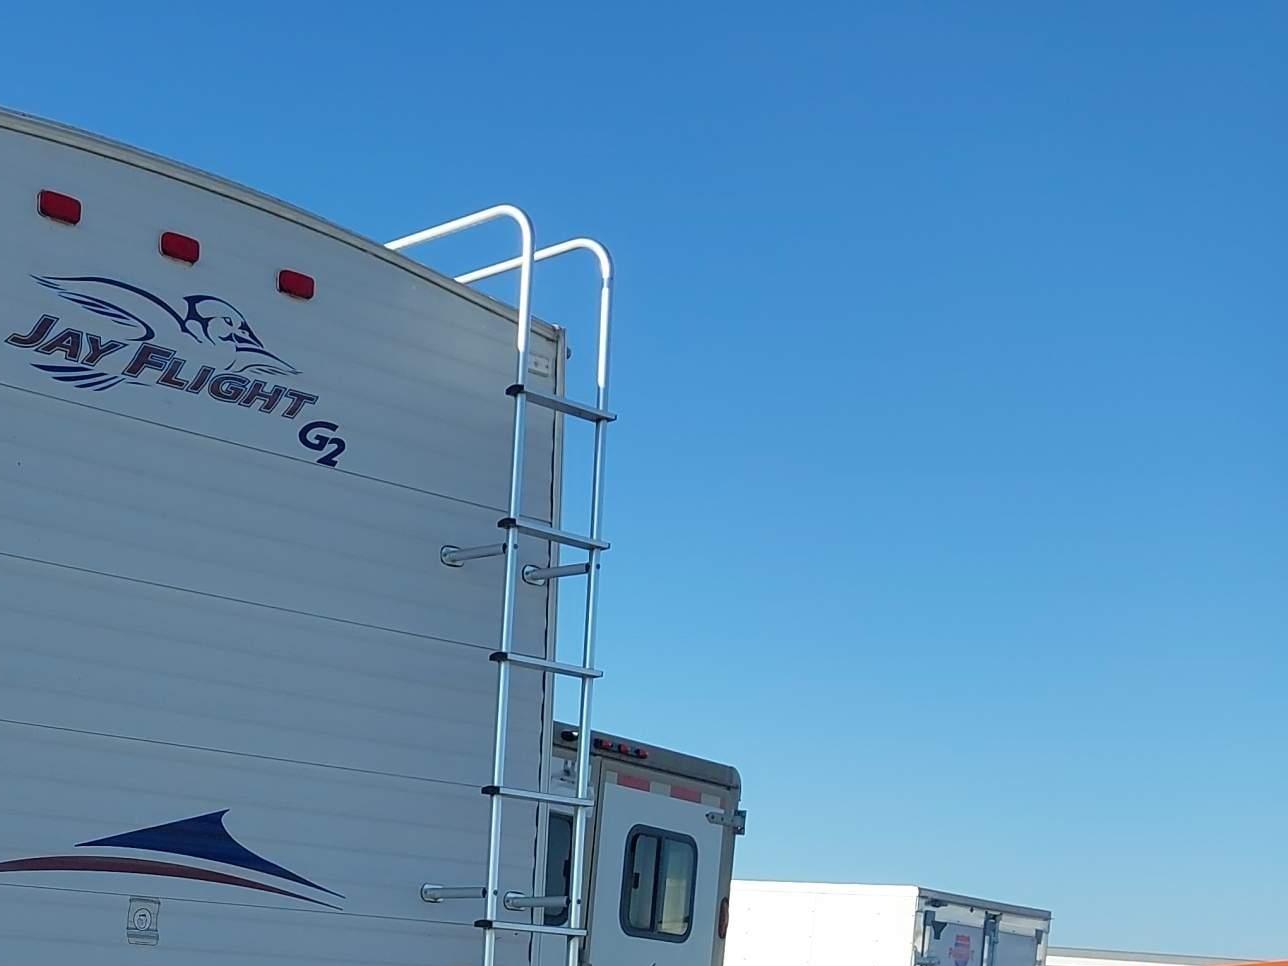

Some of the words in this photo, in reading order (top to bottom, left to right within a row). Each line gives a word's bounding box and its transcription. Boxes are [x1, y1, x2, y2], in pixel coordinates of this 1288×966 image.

[4, 313, 129, 367] JAY
[121, 342, 320, 419] FLIGHT
[298, 420, 347, 468] G2
